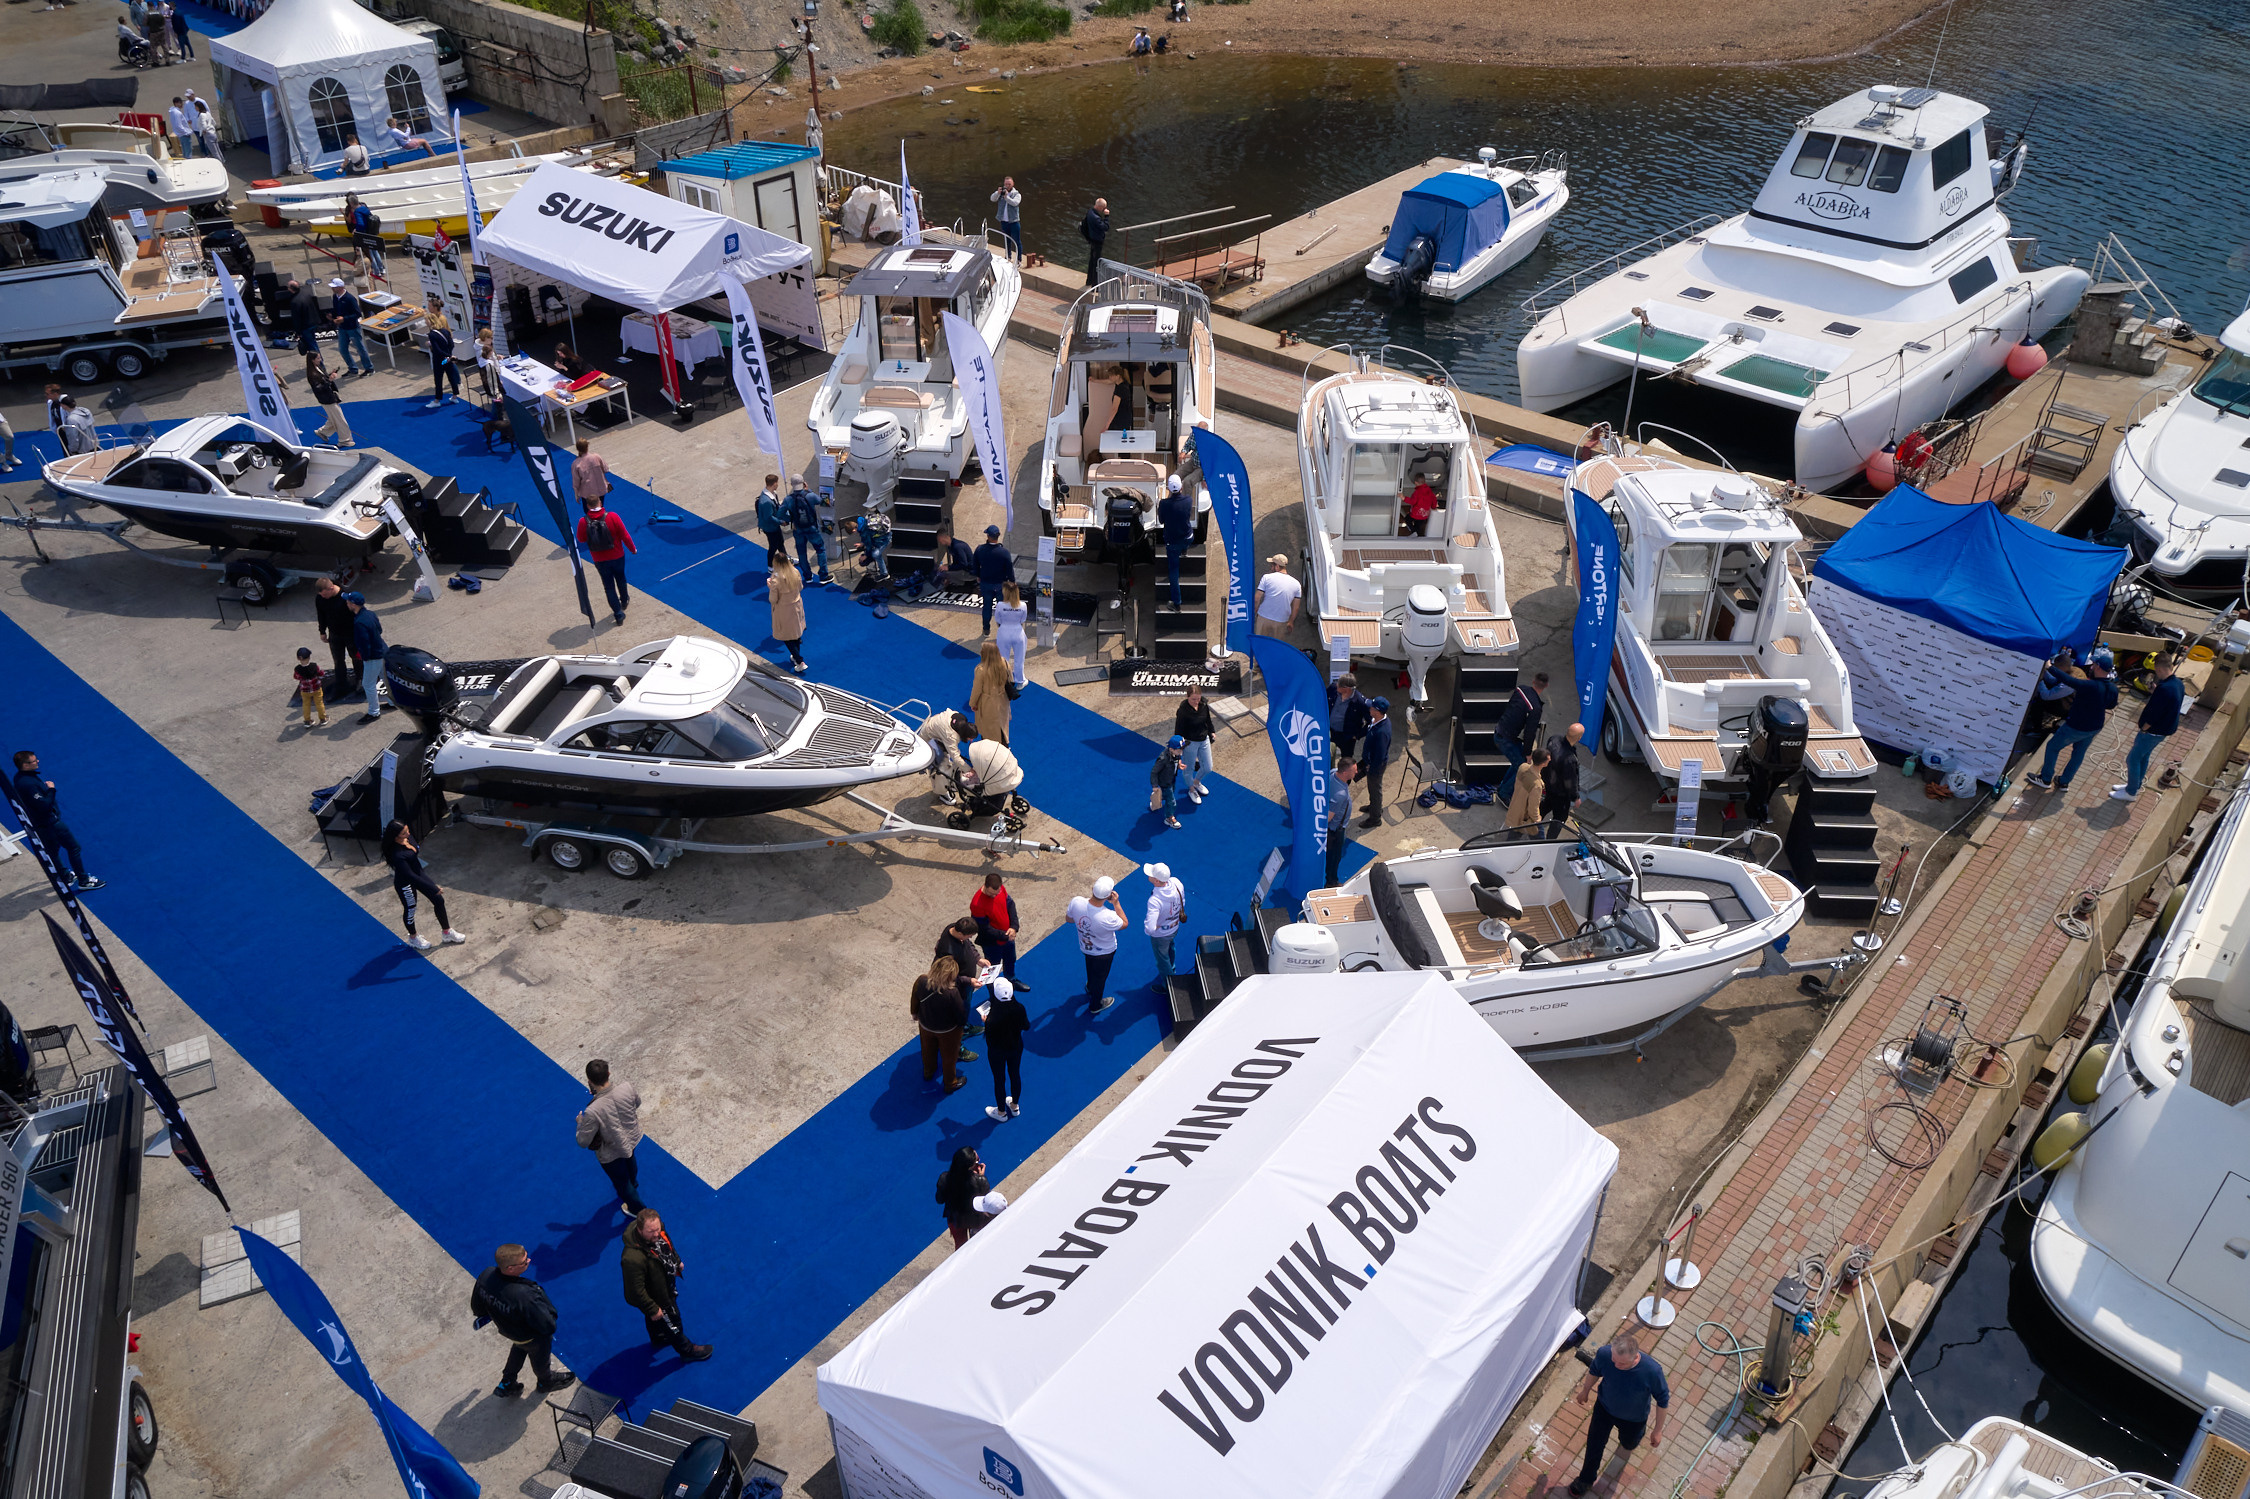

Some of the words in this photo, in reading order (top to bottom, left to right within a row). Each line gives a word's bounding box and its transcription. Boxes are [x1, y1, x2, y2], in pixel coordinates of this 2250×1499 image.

[1794, 192, 1871, 220] ALDABRA
[1939, 187, 1969, 216] ALDABRA
[538, 192, 676, 254] SUZUKI
[874, 425, 898, 441] SUZUKI
[918, 598, 979, 608] OUTBOARD
[386, 671, 425, 693] SUZUKI
[1132, 674, 1220, 683] ULTIMATE
[1286, 957, 1326, 965] SUZUKI
[1479, 1008, 1525, 1018] hoenix
[1, 1160, 19, 1194] 960
[989, 1036, 1322, 1317] VODNIK.BOATS
[1157, 1097, 1478, 1457] VODNIK.BOATS
